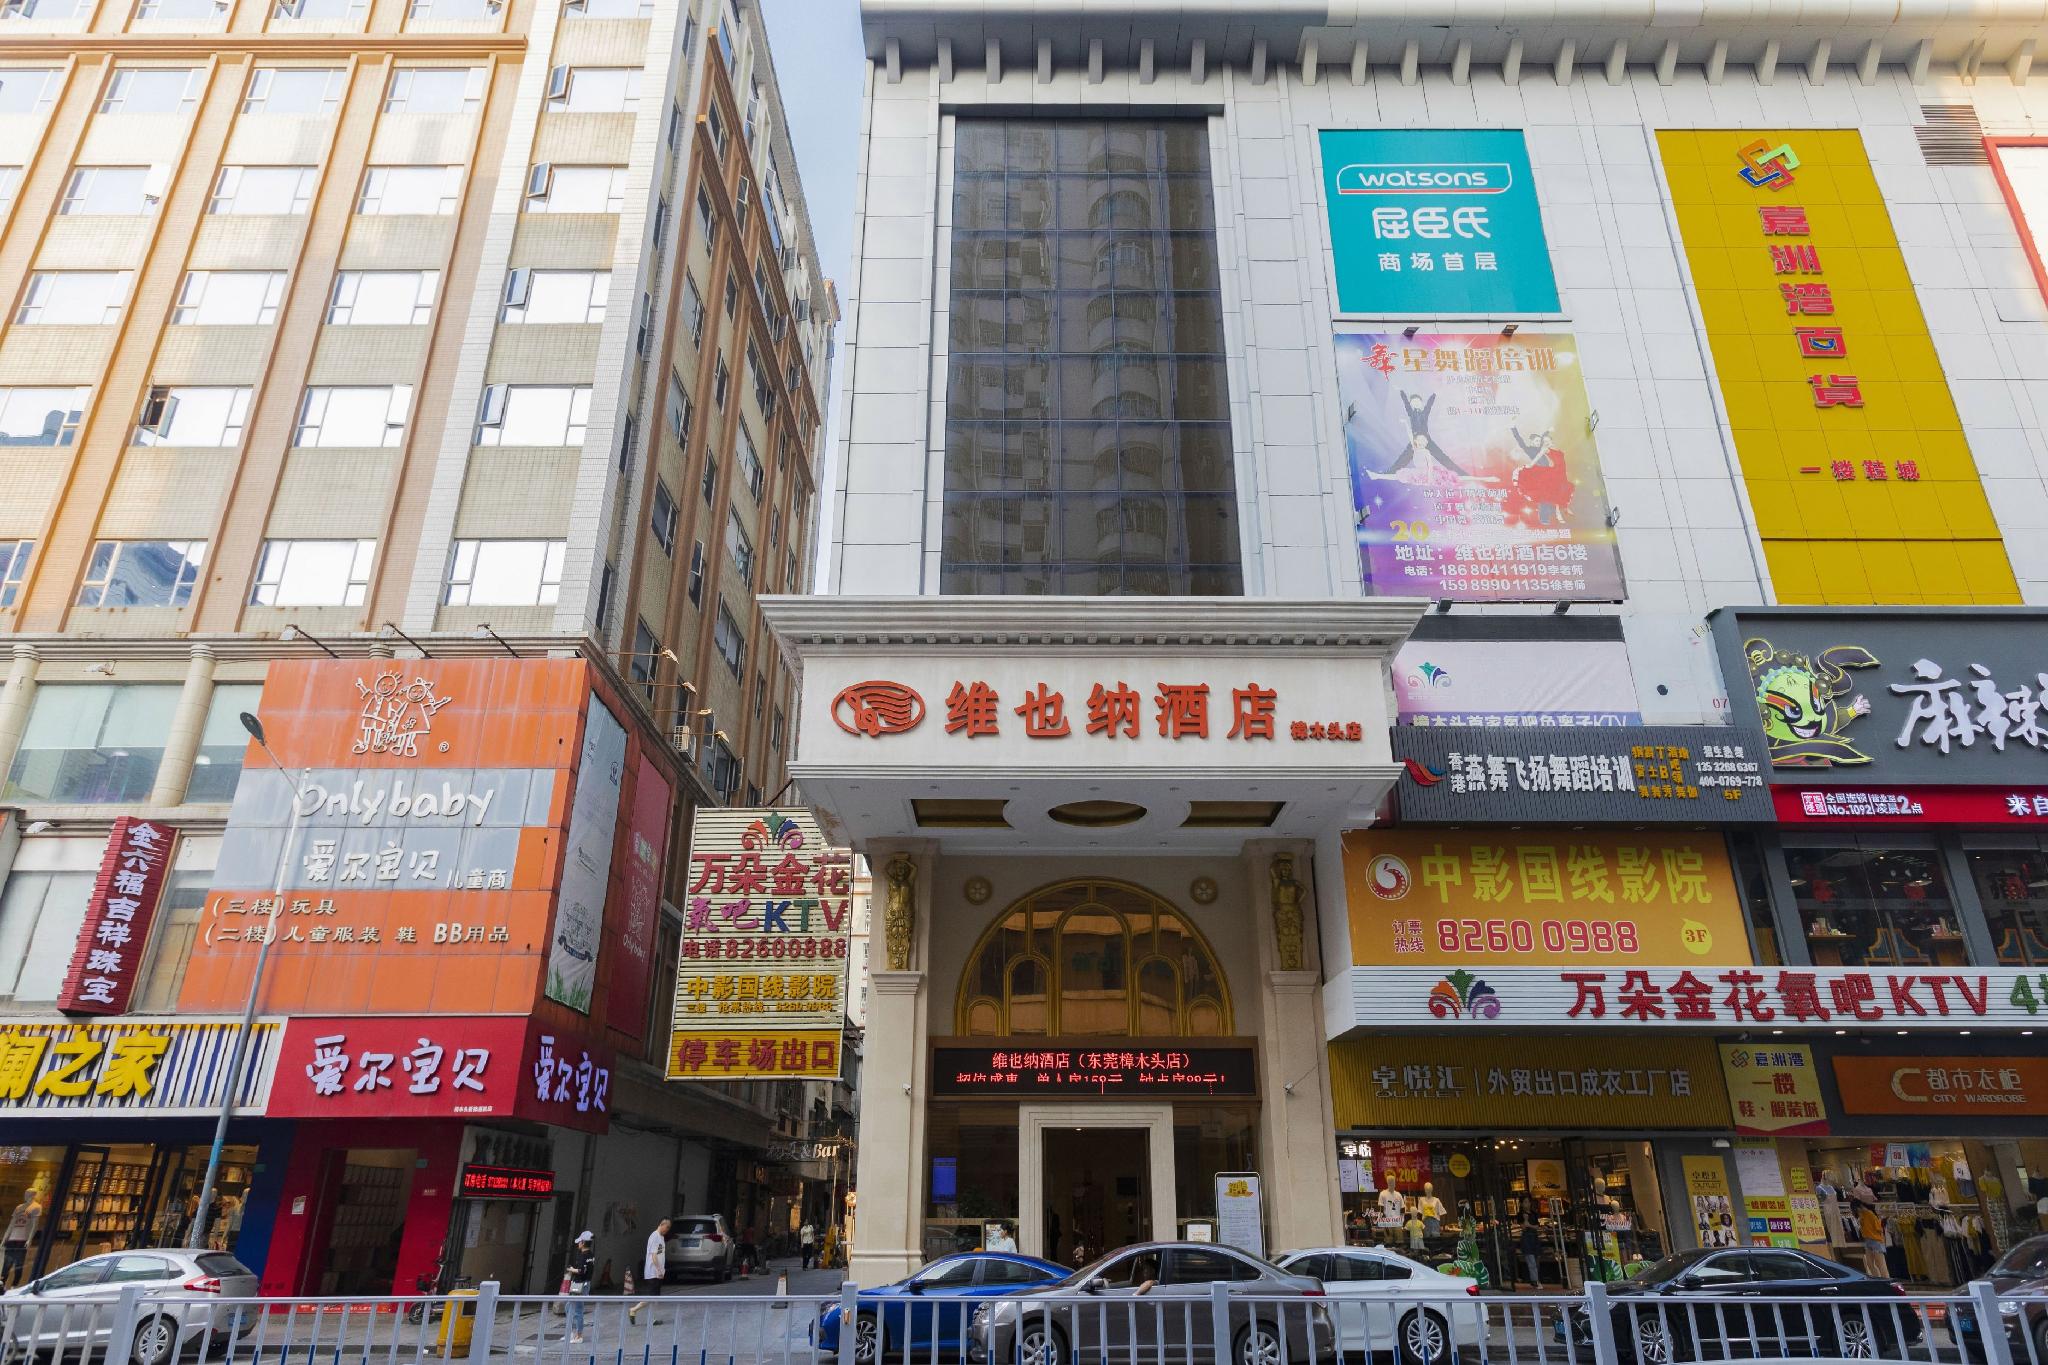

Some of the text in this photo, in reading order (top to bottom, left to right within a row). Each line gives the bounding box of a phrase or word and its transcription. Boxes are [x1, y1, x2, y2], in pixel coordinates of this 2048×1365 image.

[1358, 170, 1488, 187] watsons
[1371, 206, 1491, 239] 屈臣氏
[1377, 252, 1498, 272] 商场首层
[1799, 459, 1921, 481] 一楼鞋城
[1390, 520, 1430, 541] 20
[1454, 544, 1588, 562] 维也纳酒店6楼
[944, 680, 1279, 740] 维也纳酒店
[1290, 720, 1363, 742] 樟木头店
[1465, 753, 1635, 793] 燕舞飞扬舞蹈培训
[303, 840, 440, 882] 爱尔宝贝
[688, 852, 850, 895] 万朵金花
[1421, 844, 1712, 904] 中影国线影院
[79, 822, 161, 1004] 金六福吉祥珠宝
[1391, 919, 1423, 935] 订票
[1436, 918, 1640, 954] 8260 0988
[1684, 928, 1708, 943] 3F
[1394, 937, 1425, 954] 热线
[687, 975, 837, 1000] 中影国线影院
[1560, 969, 1988, 1022] 万朵金花氧吧KTV
[2009, 972, 2048, 1015] 4
[305, 1034, 490, 1096] 爱尔宝贝
[678, 1038, 836, 1071] 停车场出口
[1754, 1052, 1805, 1068] 嘉洲湾
[534, 1035, 609, 1112] 爱尔宝贝
[1371, 1064, 1465, 1090] 卓悦汇
[1488, 1067, 1692, 1097] 外贸出口成衣工厂店
[1751, 1072, 1796, 1095] 一楼
[1925, 1068, 2022, 1091] 都市衣柜
[1375, 1089, 1465, 1099] OUTLET
[1932, 1094, 2028, 1103] CITY WARDROBE
